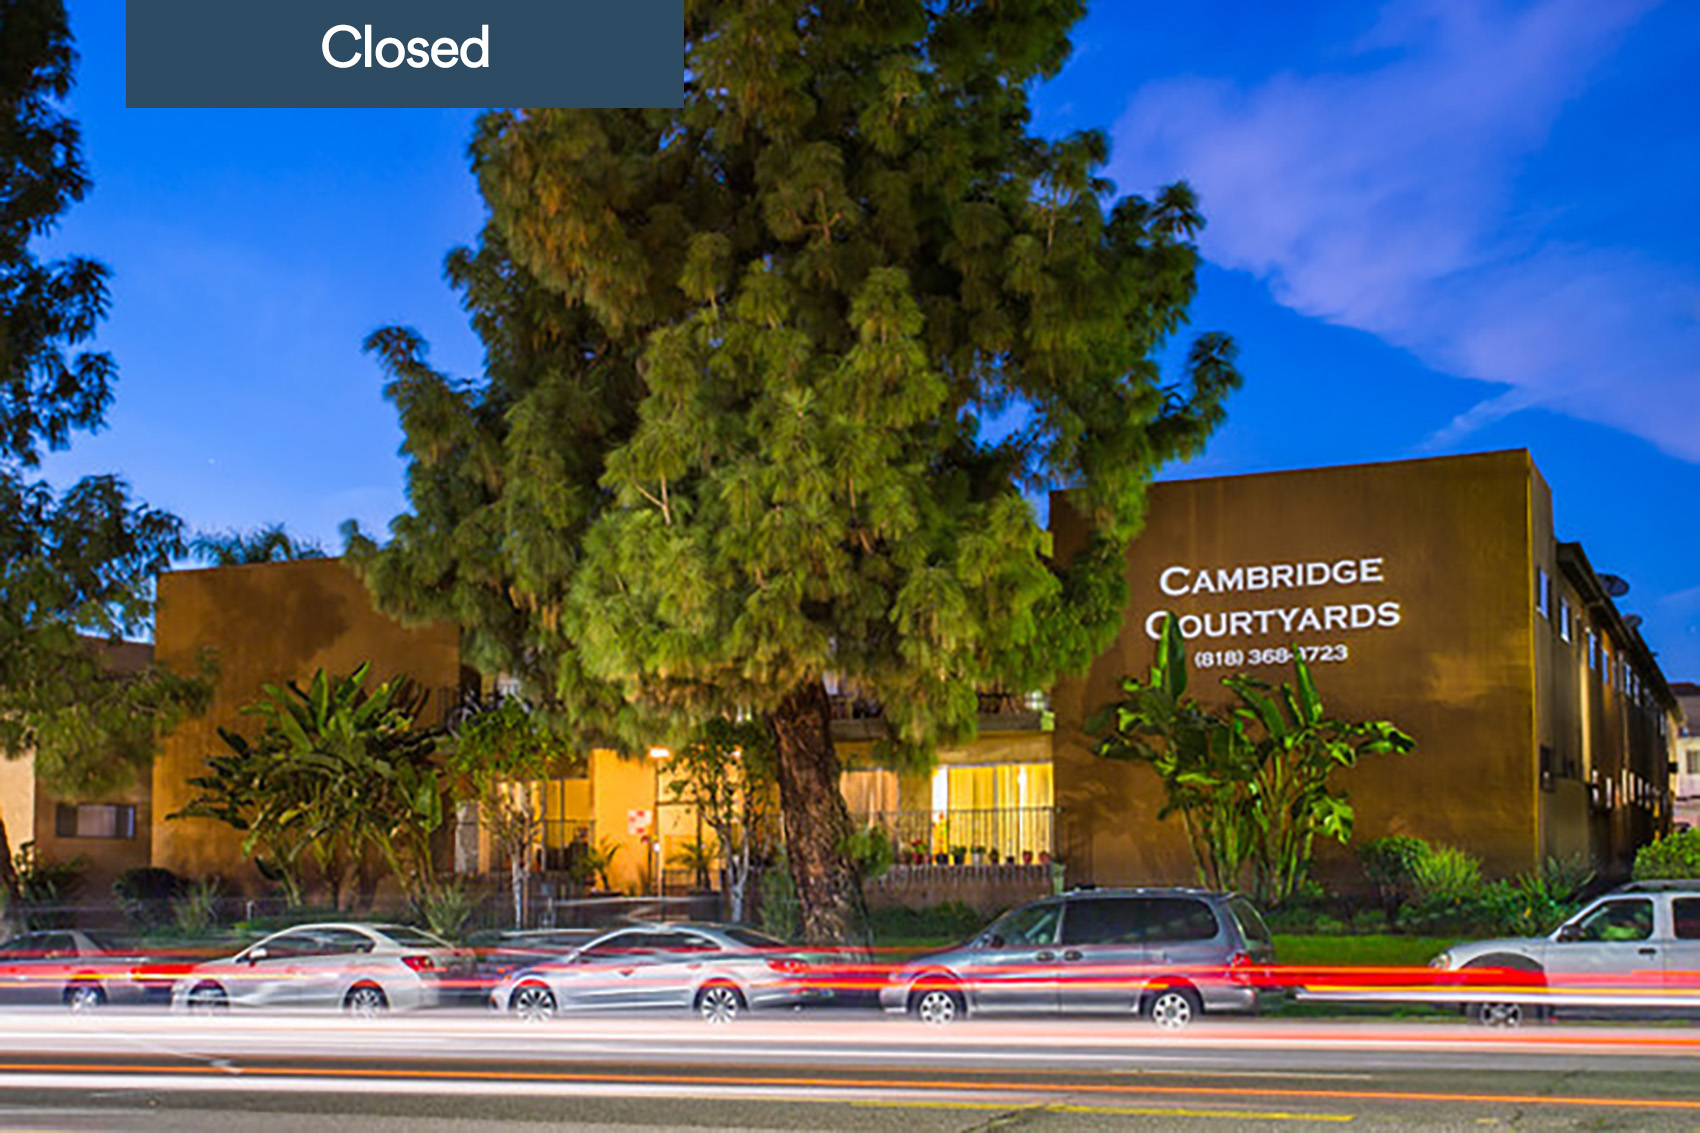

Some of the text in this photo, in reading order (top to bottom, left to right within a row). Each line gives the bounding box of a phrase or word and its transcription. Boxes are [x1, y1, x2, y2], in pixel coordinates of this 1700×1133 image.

[1160, 557, 1384, 596] CAMBRIDGE
[1145, 601, 1401, 640] COURTYARDS
[1194, 649, 1244, 668] (818)
